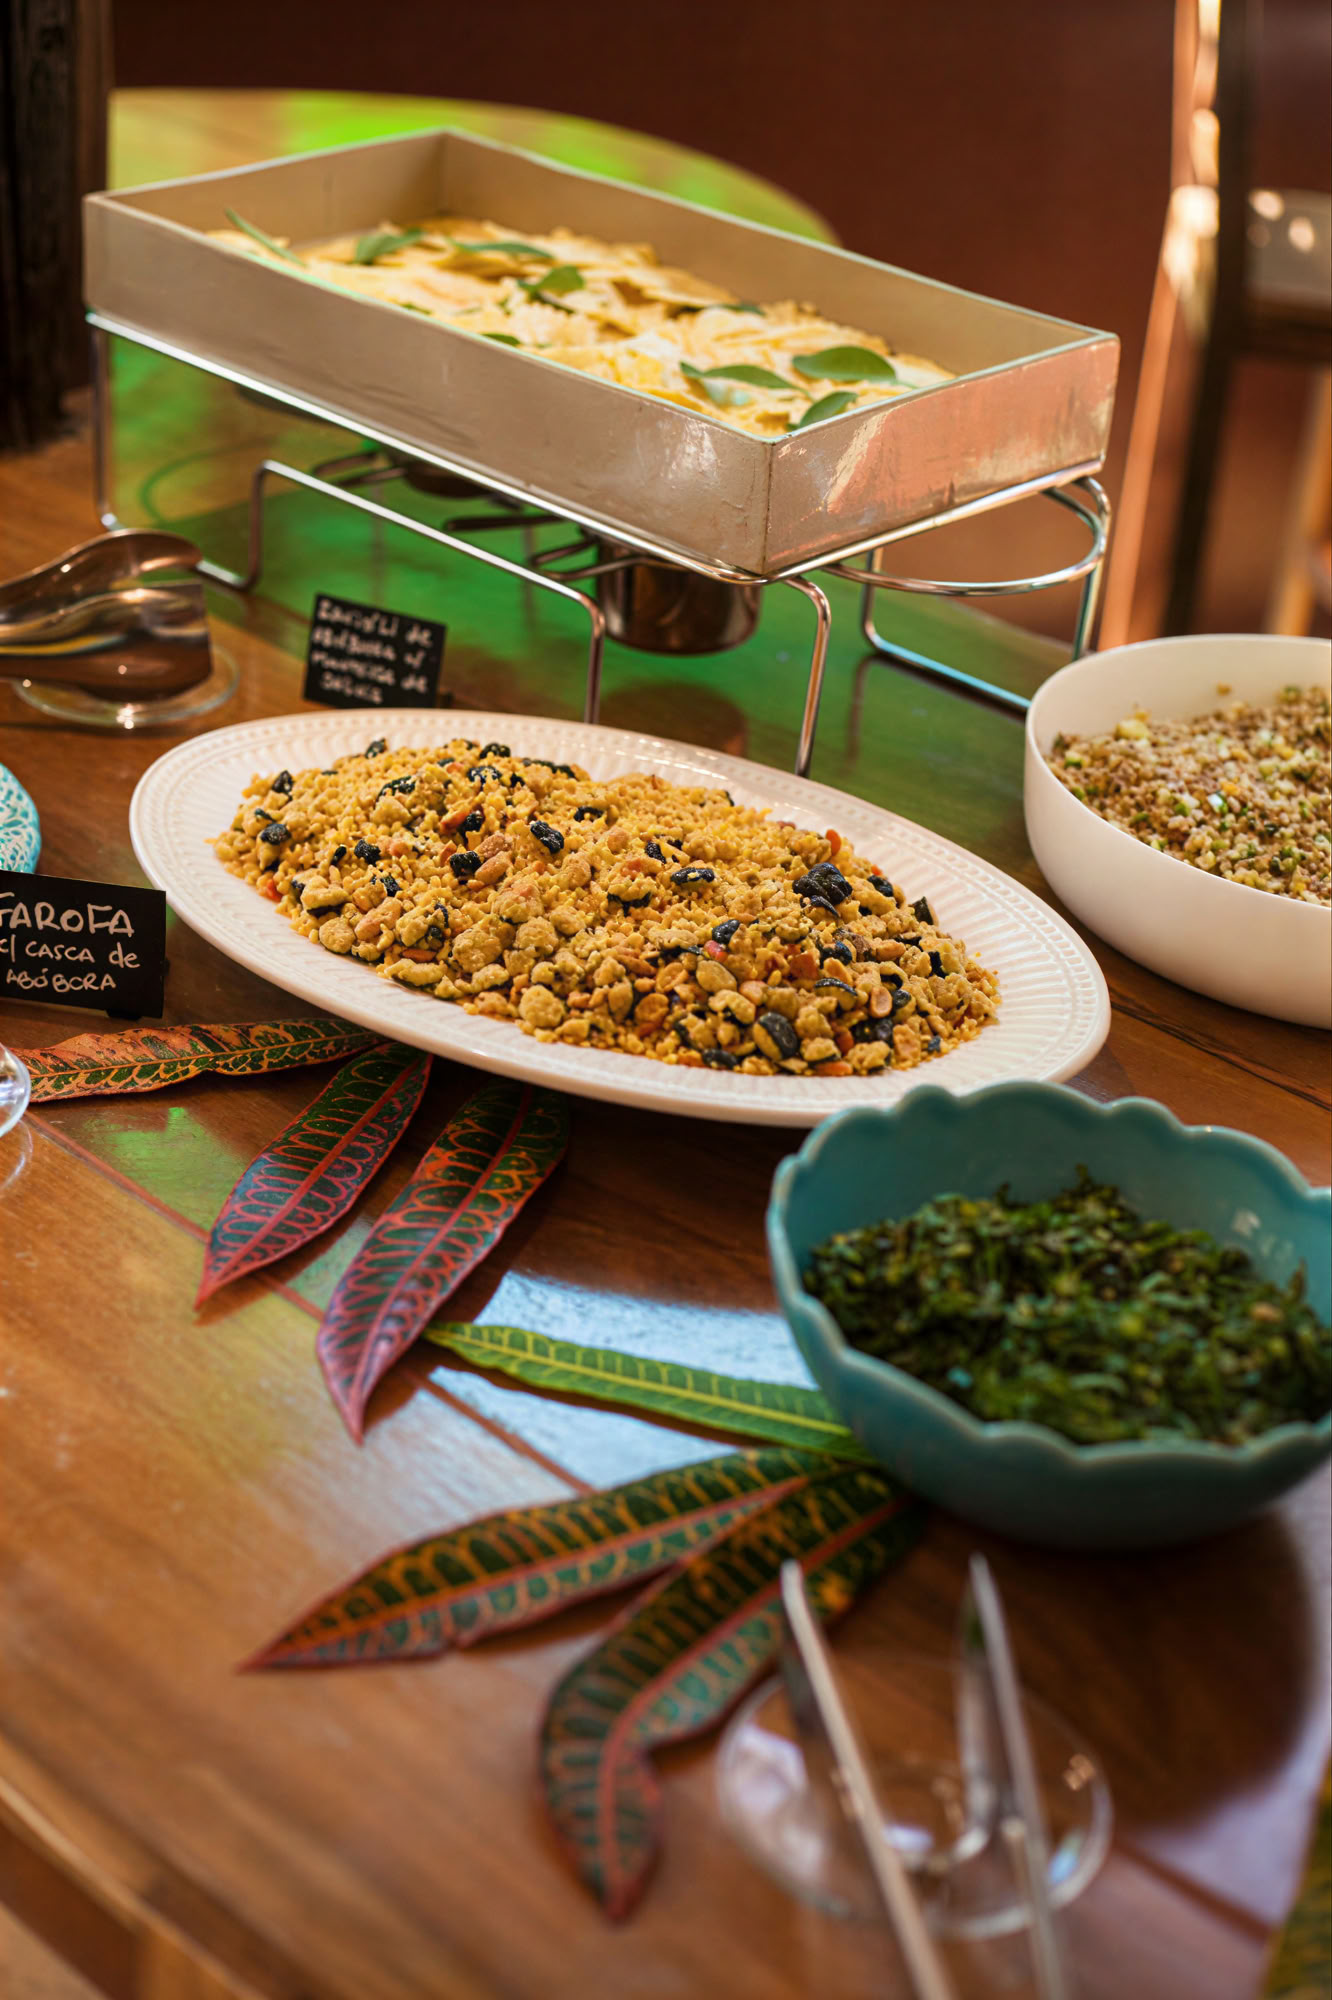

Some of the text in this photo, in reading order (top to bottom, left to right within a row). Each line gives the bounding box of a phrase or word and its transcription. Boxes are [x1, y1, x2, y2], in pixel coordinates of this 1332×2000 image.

[0, 891, 135, 938] FAROFA
[25, 940, 95, 963] CASCA
[108, 941, 141, 968] de
[6, 968, 117, 993] ABÓBORA
